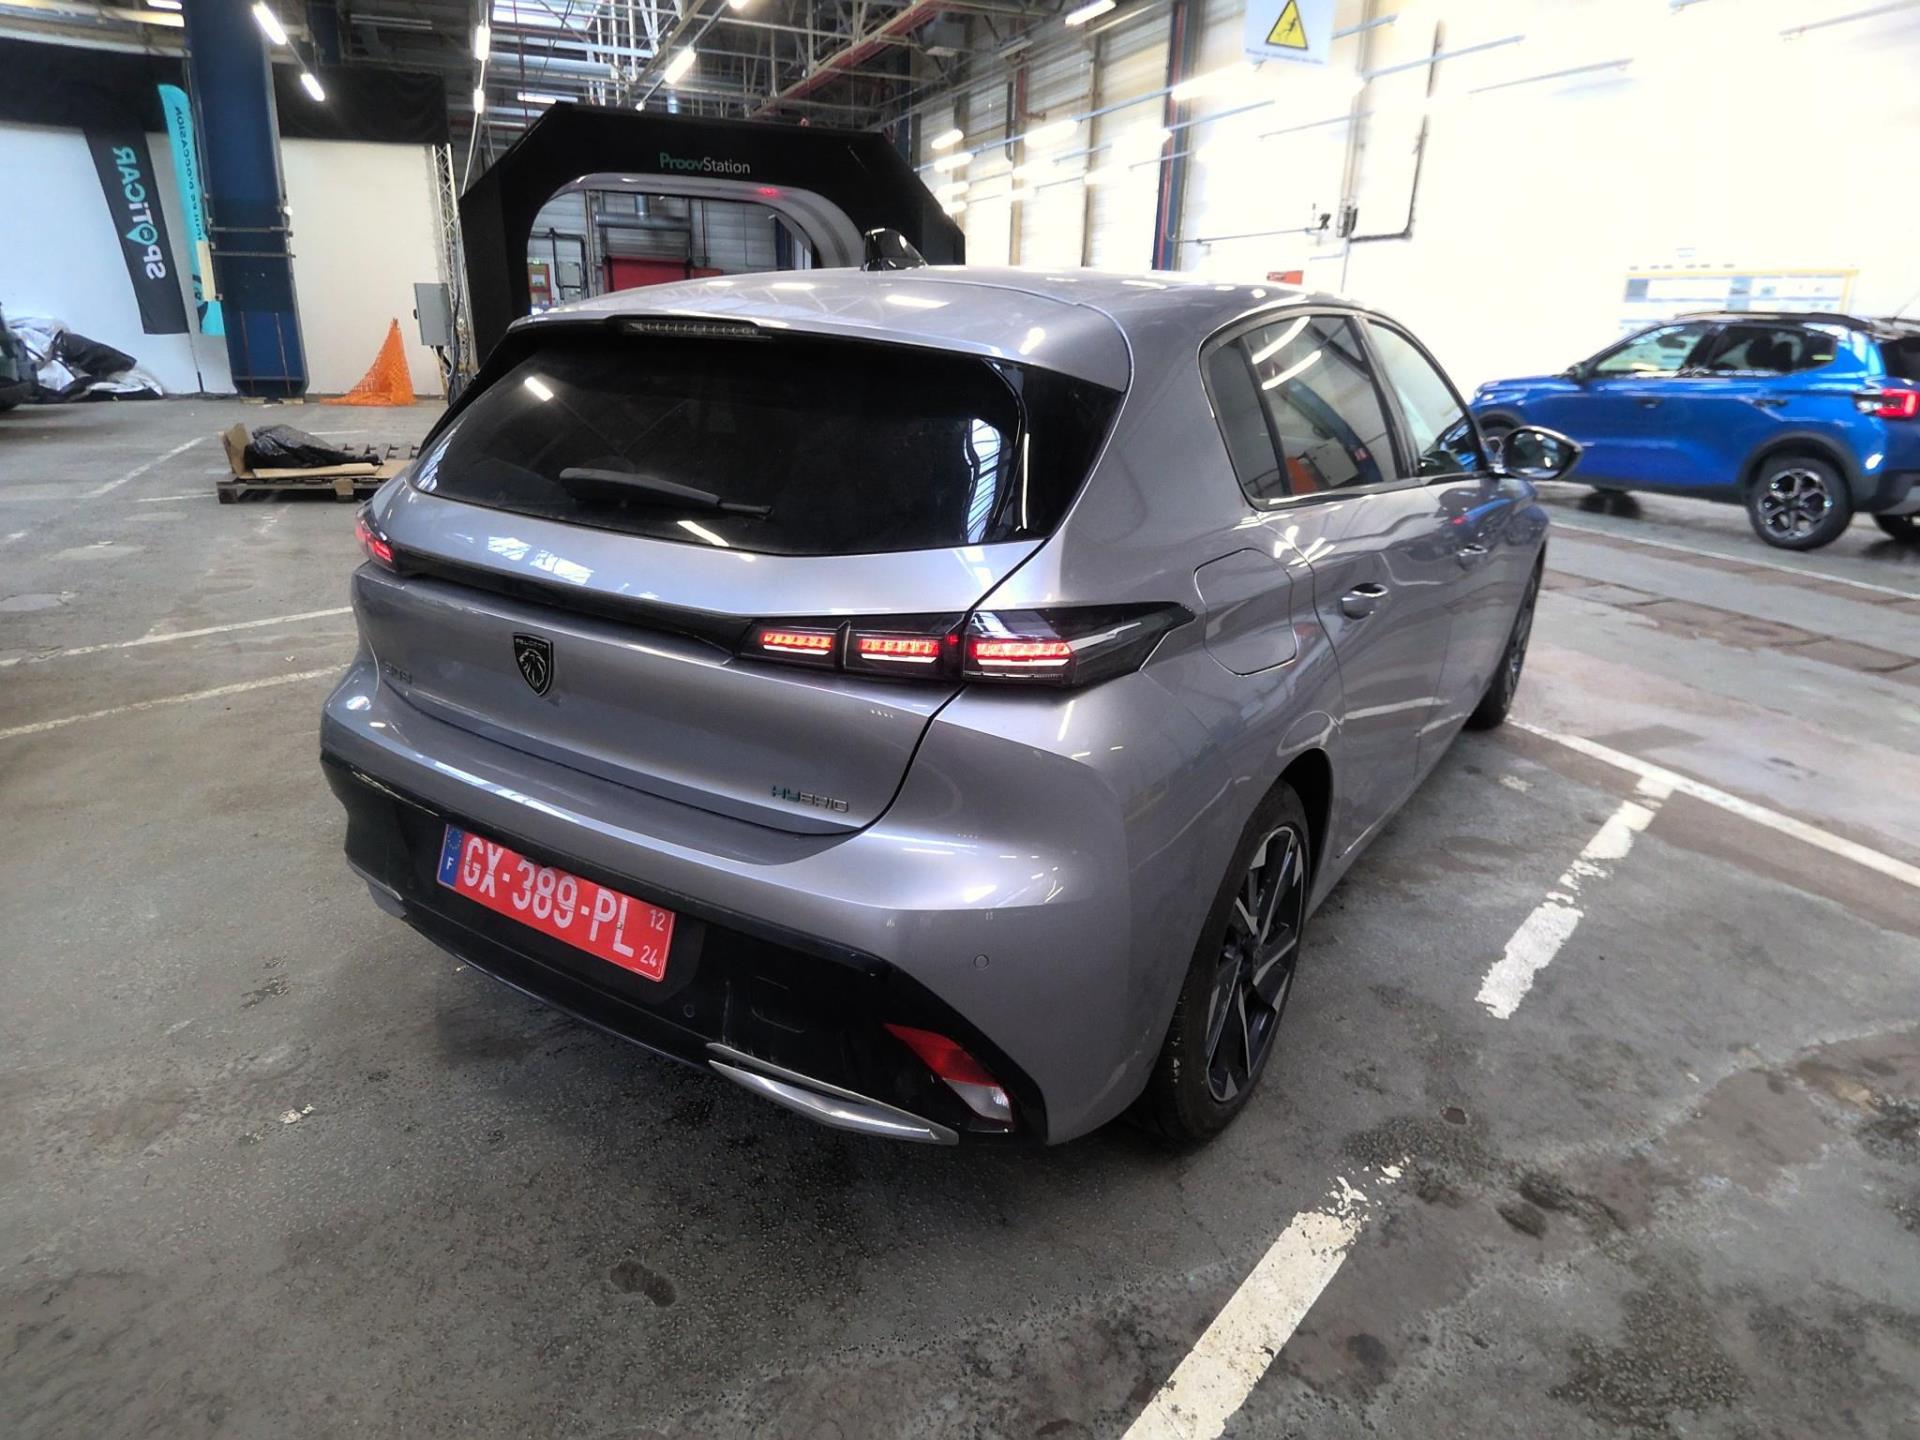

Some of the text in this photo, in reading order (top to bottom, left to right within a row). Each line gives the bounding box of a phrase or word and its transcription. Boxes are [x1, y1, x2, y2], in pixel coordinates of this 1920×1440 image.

[659, 152, 751, 174] ProovStation
[446, 857, 454, 870] F
[463, 837, 634, 958] GX-389-PL
[649, 909, 666, 932] 12
[640, 944, 658, 968] 24
